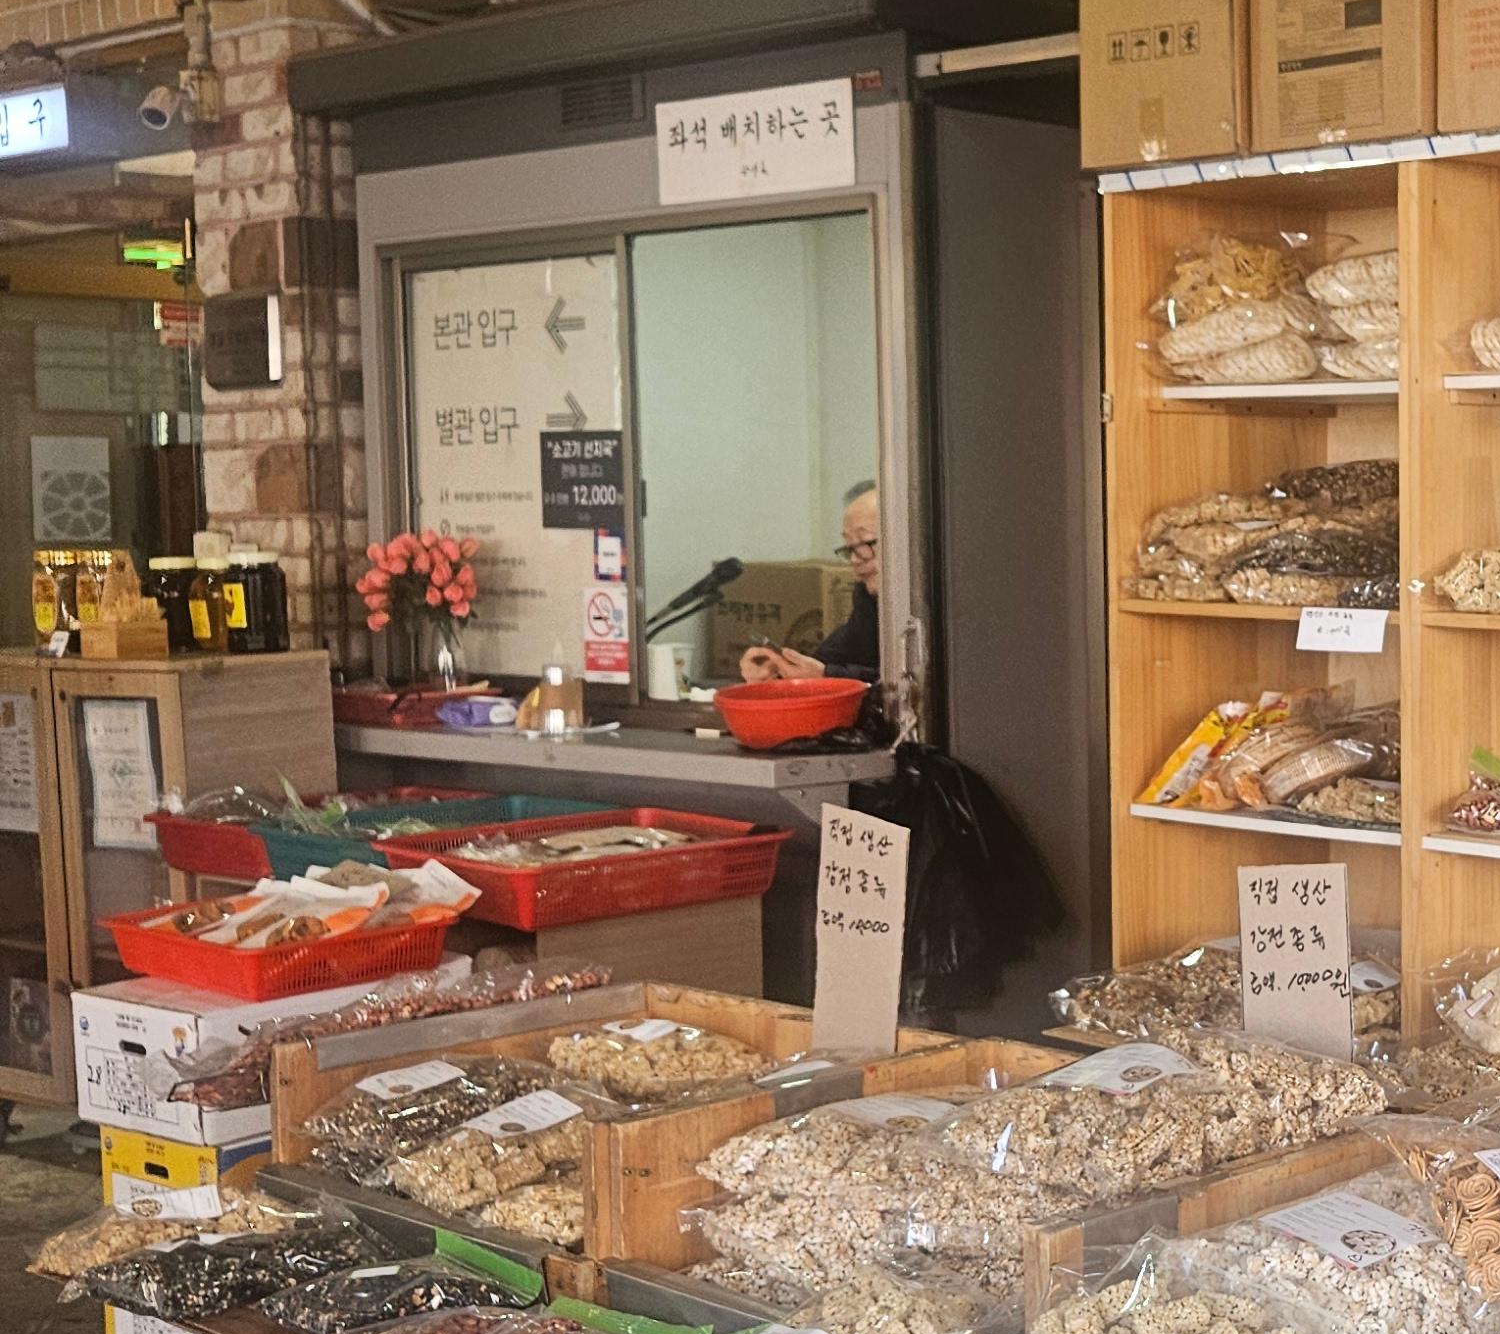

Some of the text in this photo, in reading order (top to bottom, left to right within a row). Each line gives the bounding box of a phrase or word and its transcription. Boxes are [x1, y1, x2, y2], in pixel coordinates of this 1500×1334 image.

[669, 101, 841, 150] 좌석 배치하는 곳
[433, 308, 519, 351] 본관 입구
[436, 404, 520, 447] 별관 입구
[829, 819, 893, 856] 직접 생산
[825, 860, 887, 899] 강정 종류
[1249, 877, 1332, 906] 직접 생산
[821, 909, 844, 931] 금액
[1290, 925, 1325, 952] 종류
